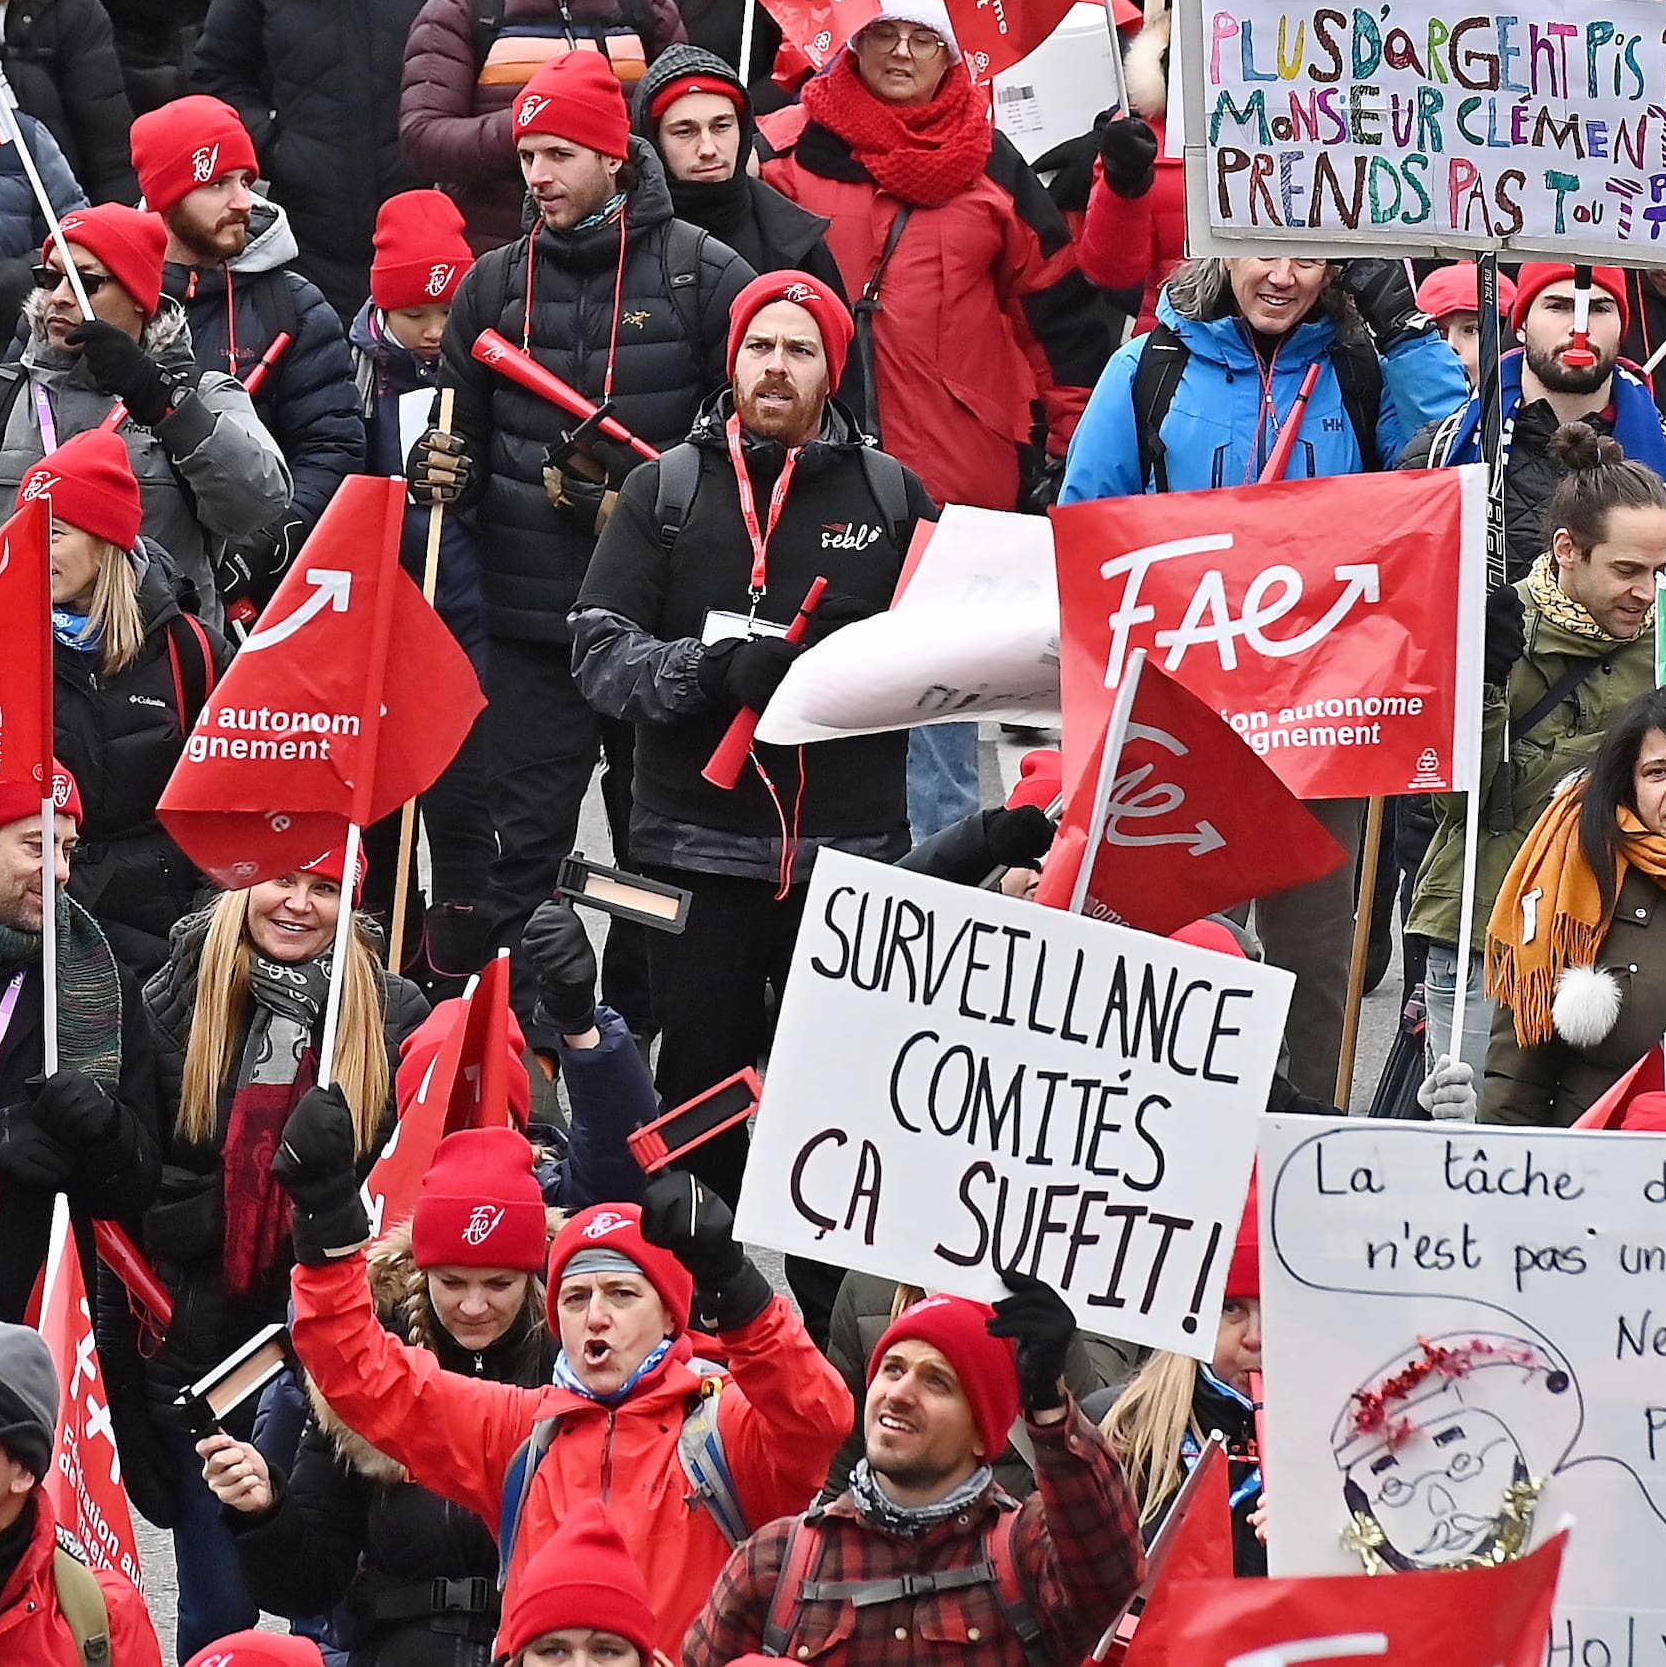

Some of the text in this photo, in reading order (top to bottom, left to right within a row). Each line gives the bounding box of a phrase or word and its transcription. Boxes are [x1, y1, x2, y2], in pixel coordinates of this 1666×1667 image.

[1210, 8, 1347, 84] PLUS
[1216, 146, 1431, 230] PRENDS
[1448, 157, 1526, 237] PAS
[1274, 695, 1424, 725] autonome
[811, 885, 1253, 1084] SURVEILLANCE
[890, 1031, 1172, 1192] COMITÉS
[1316, 1143, 1385, 1196] La
[1444, 1140, 1584, 1201] tâche
[790, 1128, 1222, 1334] ÇA SUFFIT!
[1366, 1223, 1482, 1271] n'est
[1514, 1238, 1588, 1291] pas
[1620, 1244, 1666, 1273] un
